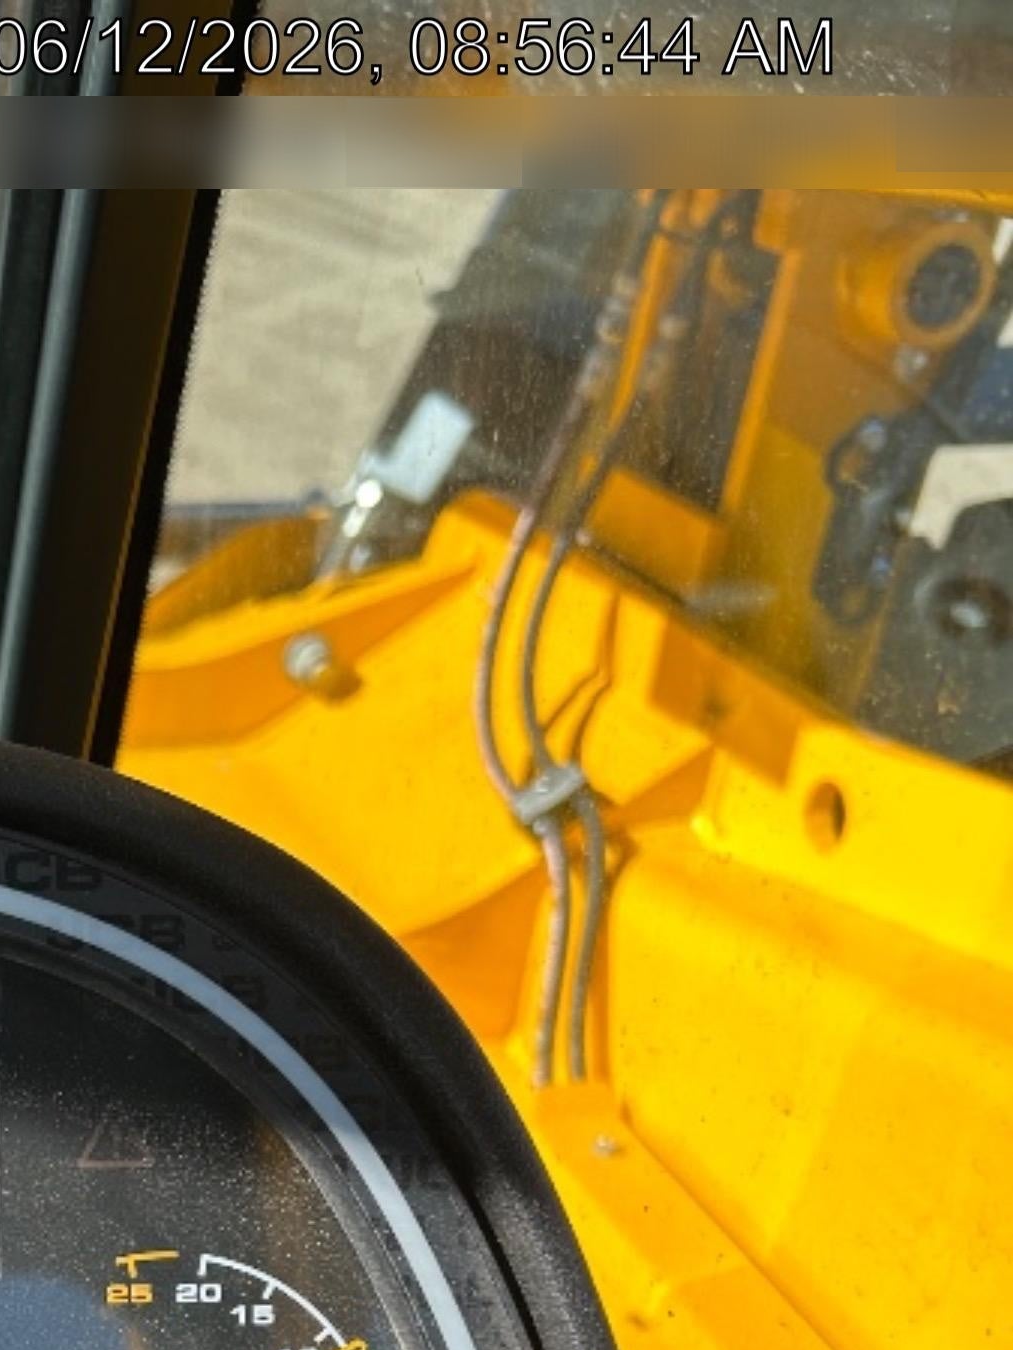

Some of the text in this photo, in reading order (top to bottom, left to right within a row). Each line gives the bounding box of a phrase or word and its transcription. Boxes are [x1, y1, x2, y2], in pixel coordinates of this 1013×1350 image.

[106, 1283, 154, 1304] 25
[175, 1283, 222, 1303] 20
[230, 1303, 275, 1326] 15
